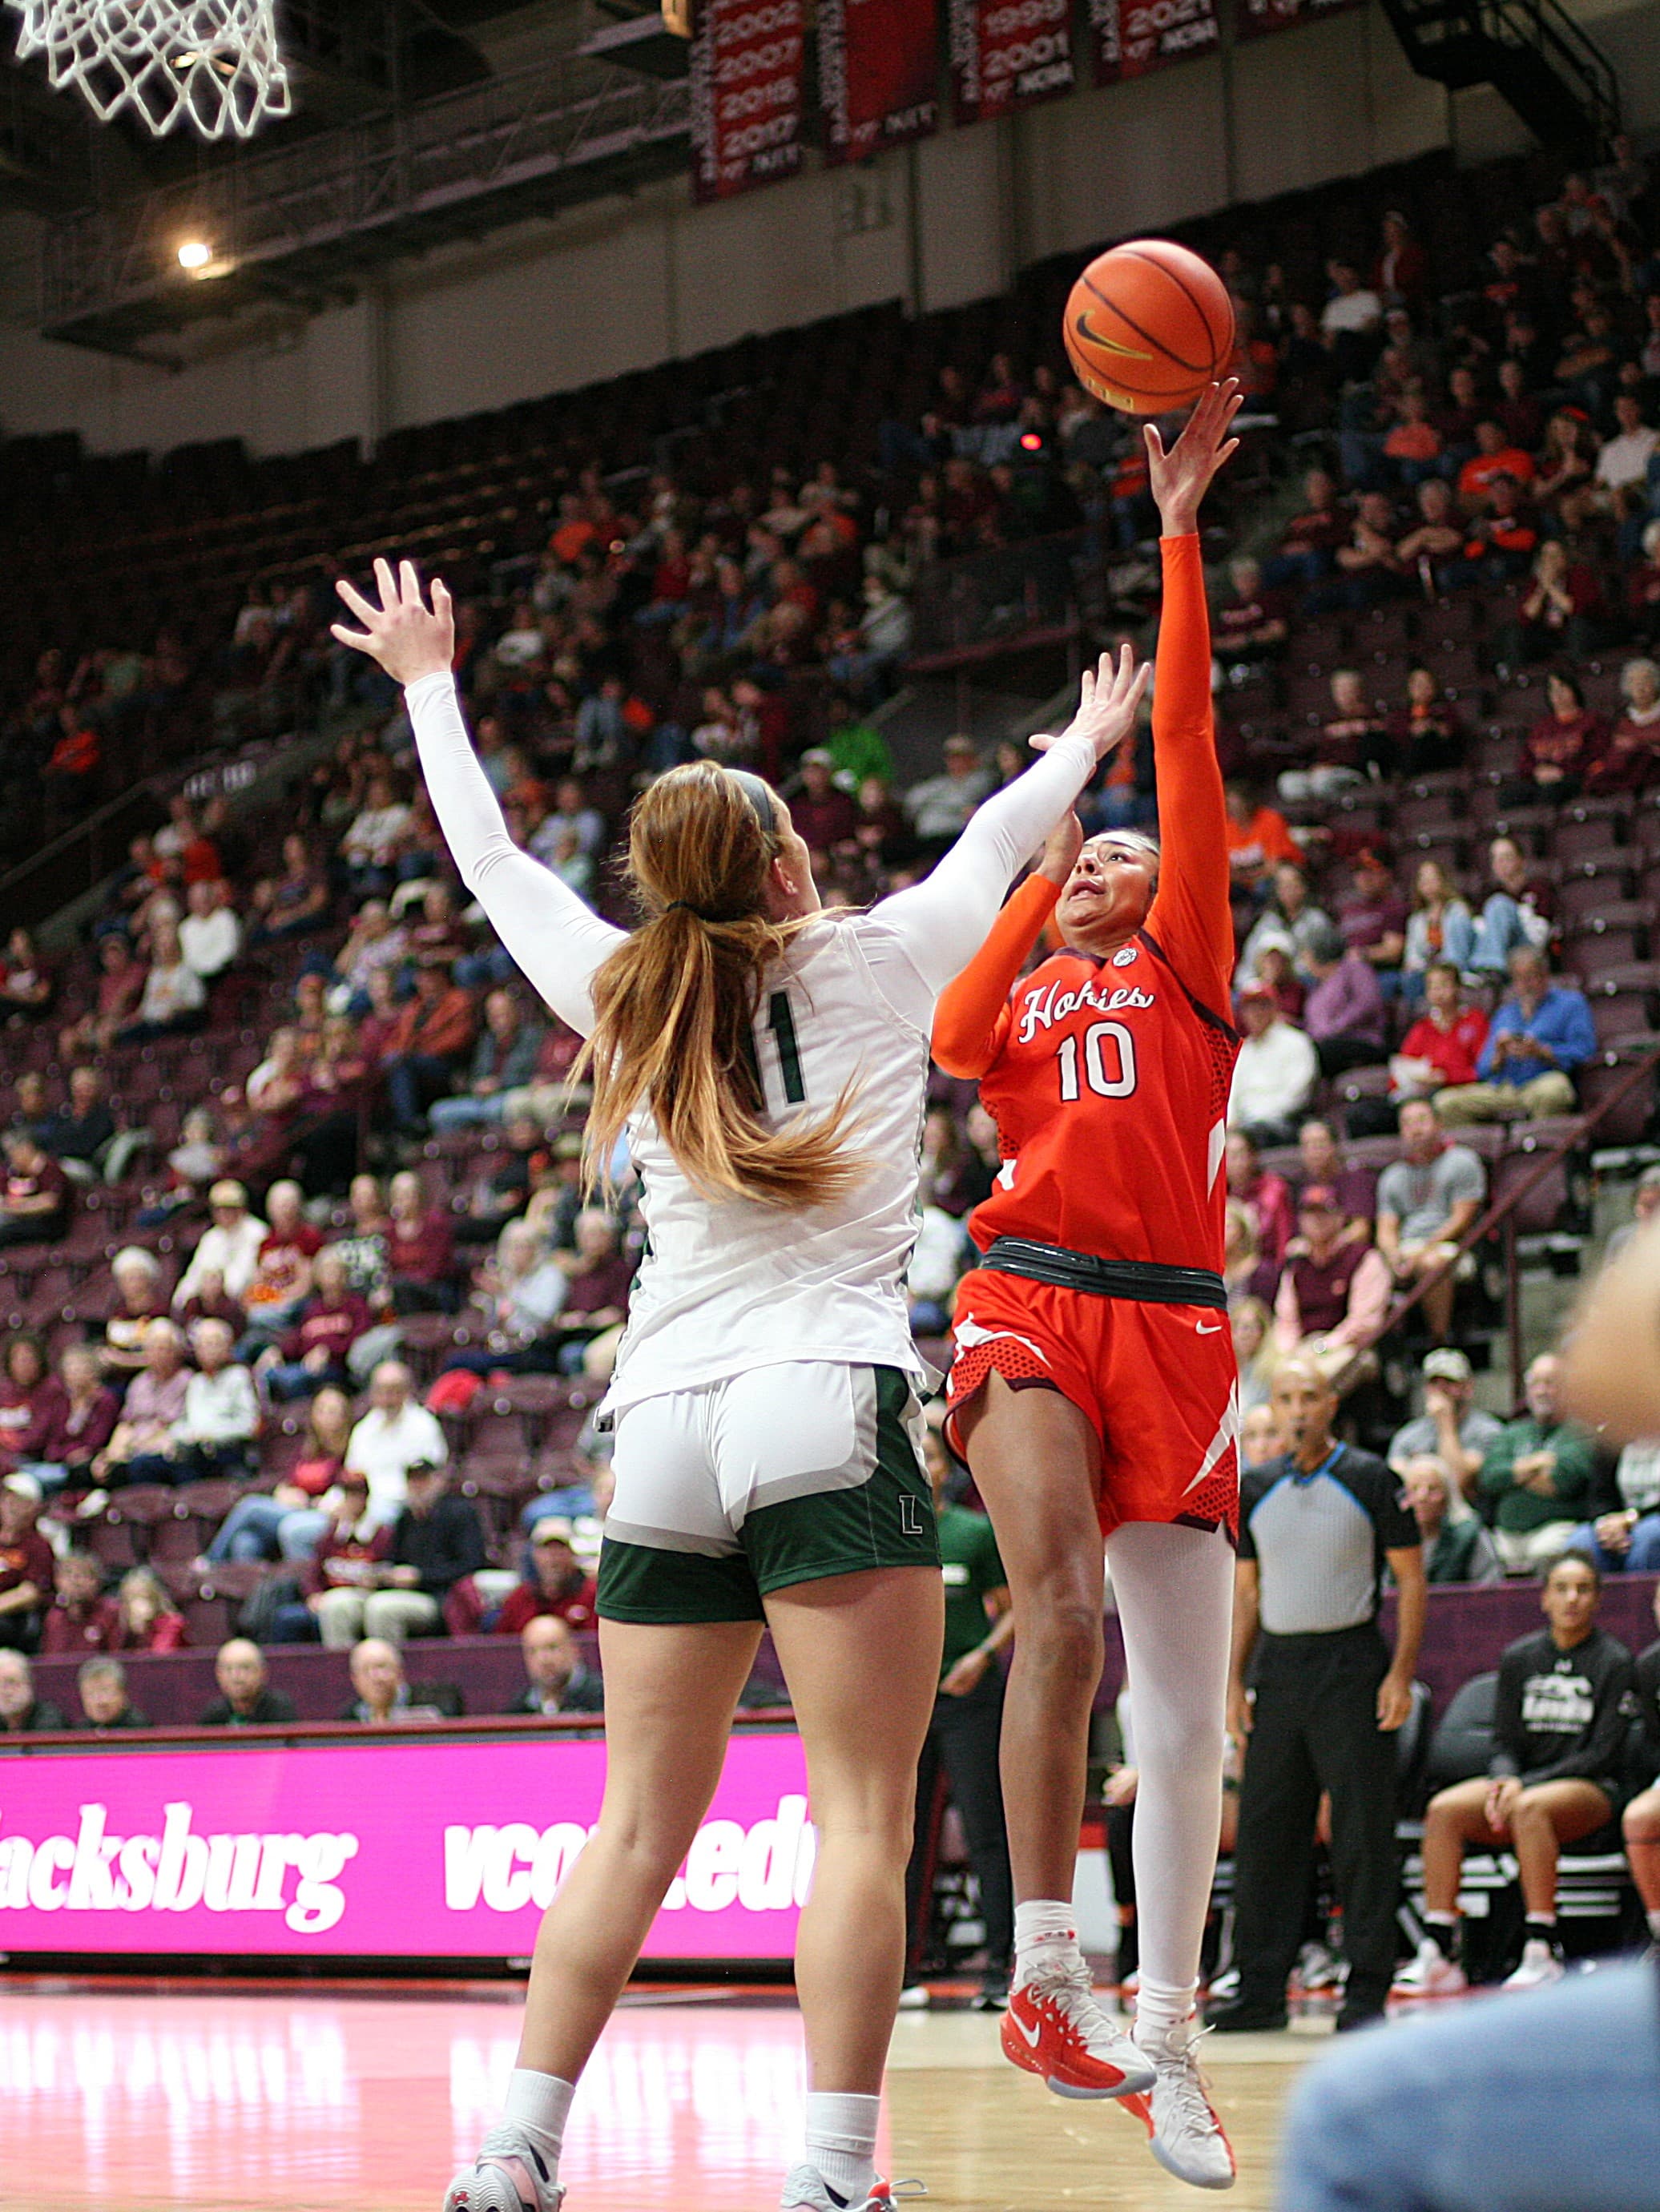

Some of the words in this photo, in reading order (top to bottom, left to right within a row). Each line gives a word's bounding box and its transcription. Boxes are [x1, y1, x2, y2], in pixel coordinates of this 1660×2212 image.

[983, 28, 1070, 76] 2001
[1018, 979, 1155, 1044] Hokies
[1056, 1020, 1138, 1102] 10
[899, 1495, 923, 1534] L
